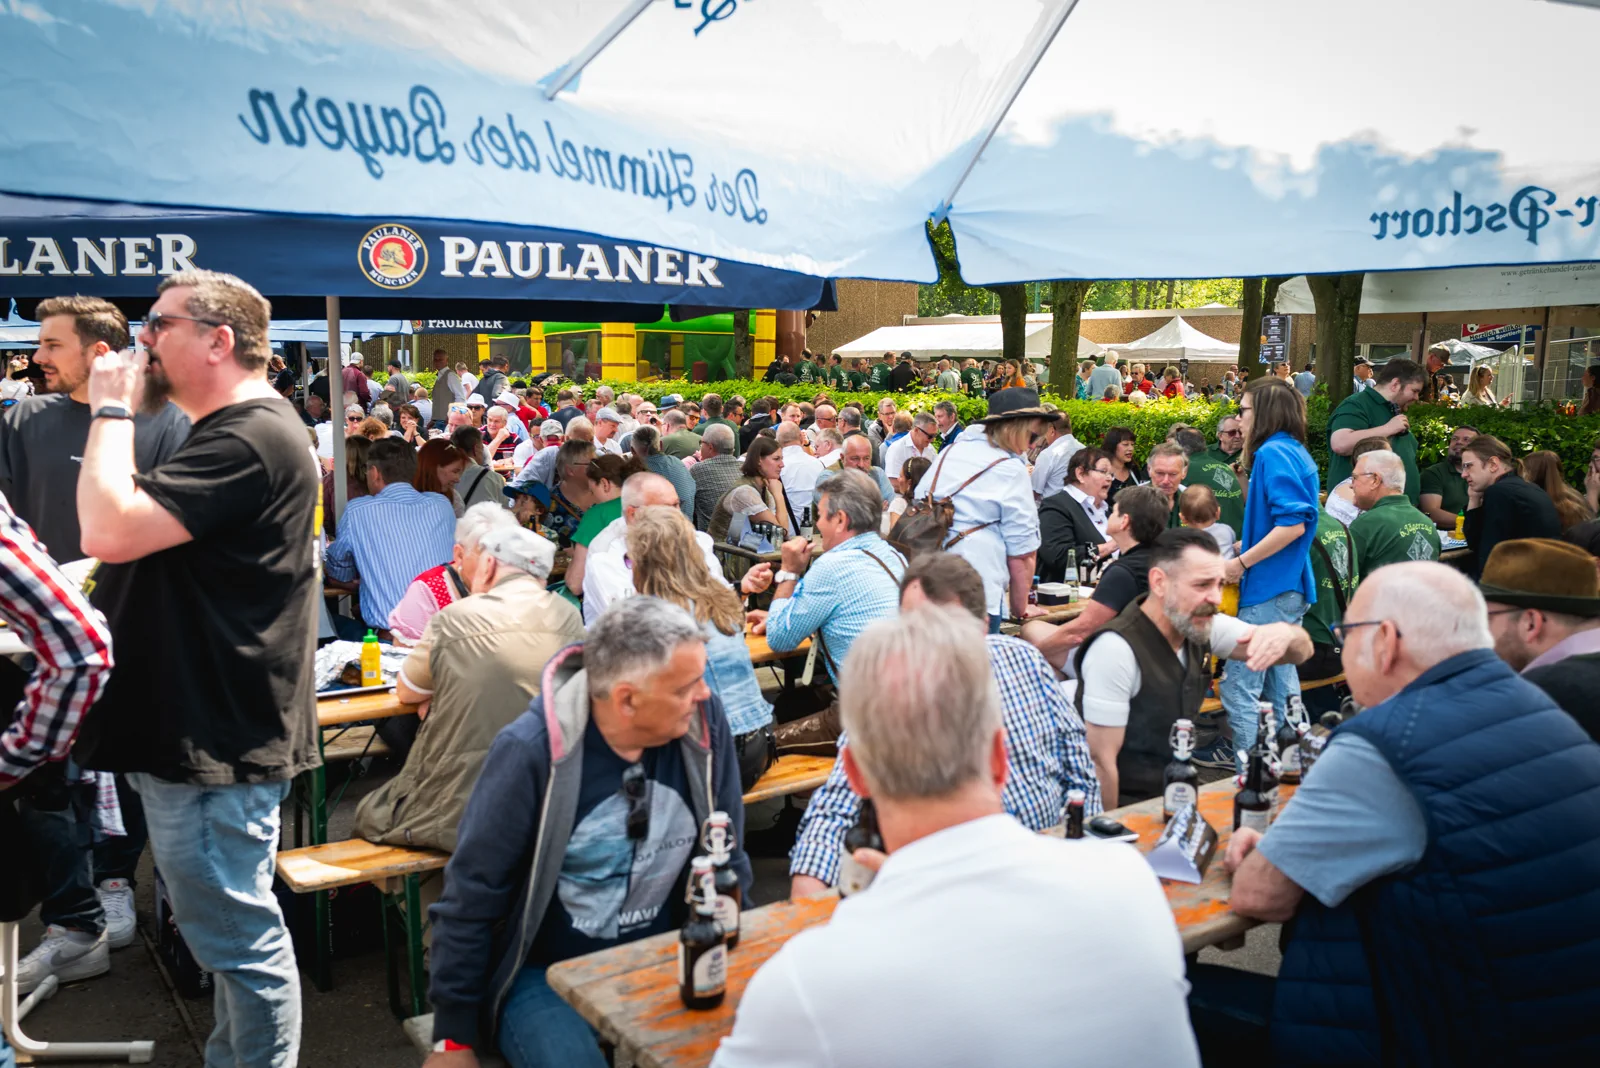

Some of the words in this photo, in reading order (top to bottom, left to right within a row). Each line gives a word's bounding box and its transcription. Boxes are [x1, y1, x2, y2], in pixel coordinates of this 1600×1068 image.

[362, 227, 422, 250] PAULANER
[0, 232, 199, 277] LANER
[439, 235, 725, 289] PAULANER
[427, 319, 504, 329] PAULANER
[1495, 327, 1533, 340] Sportlerhm
